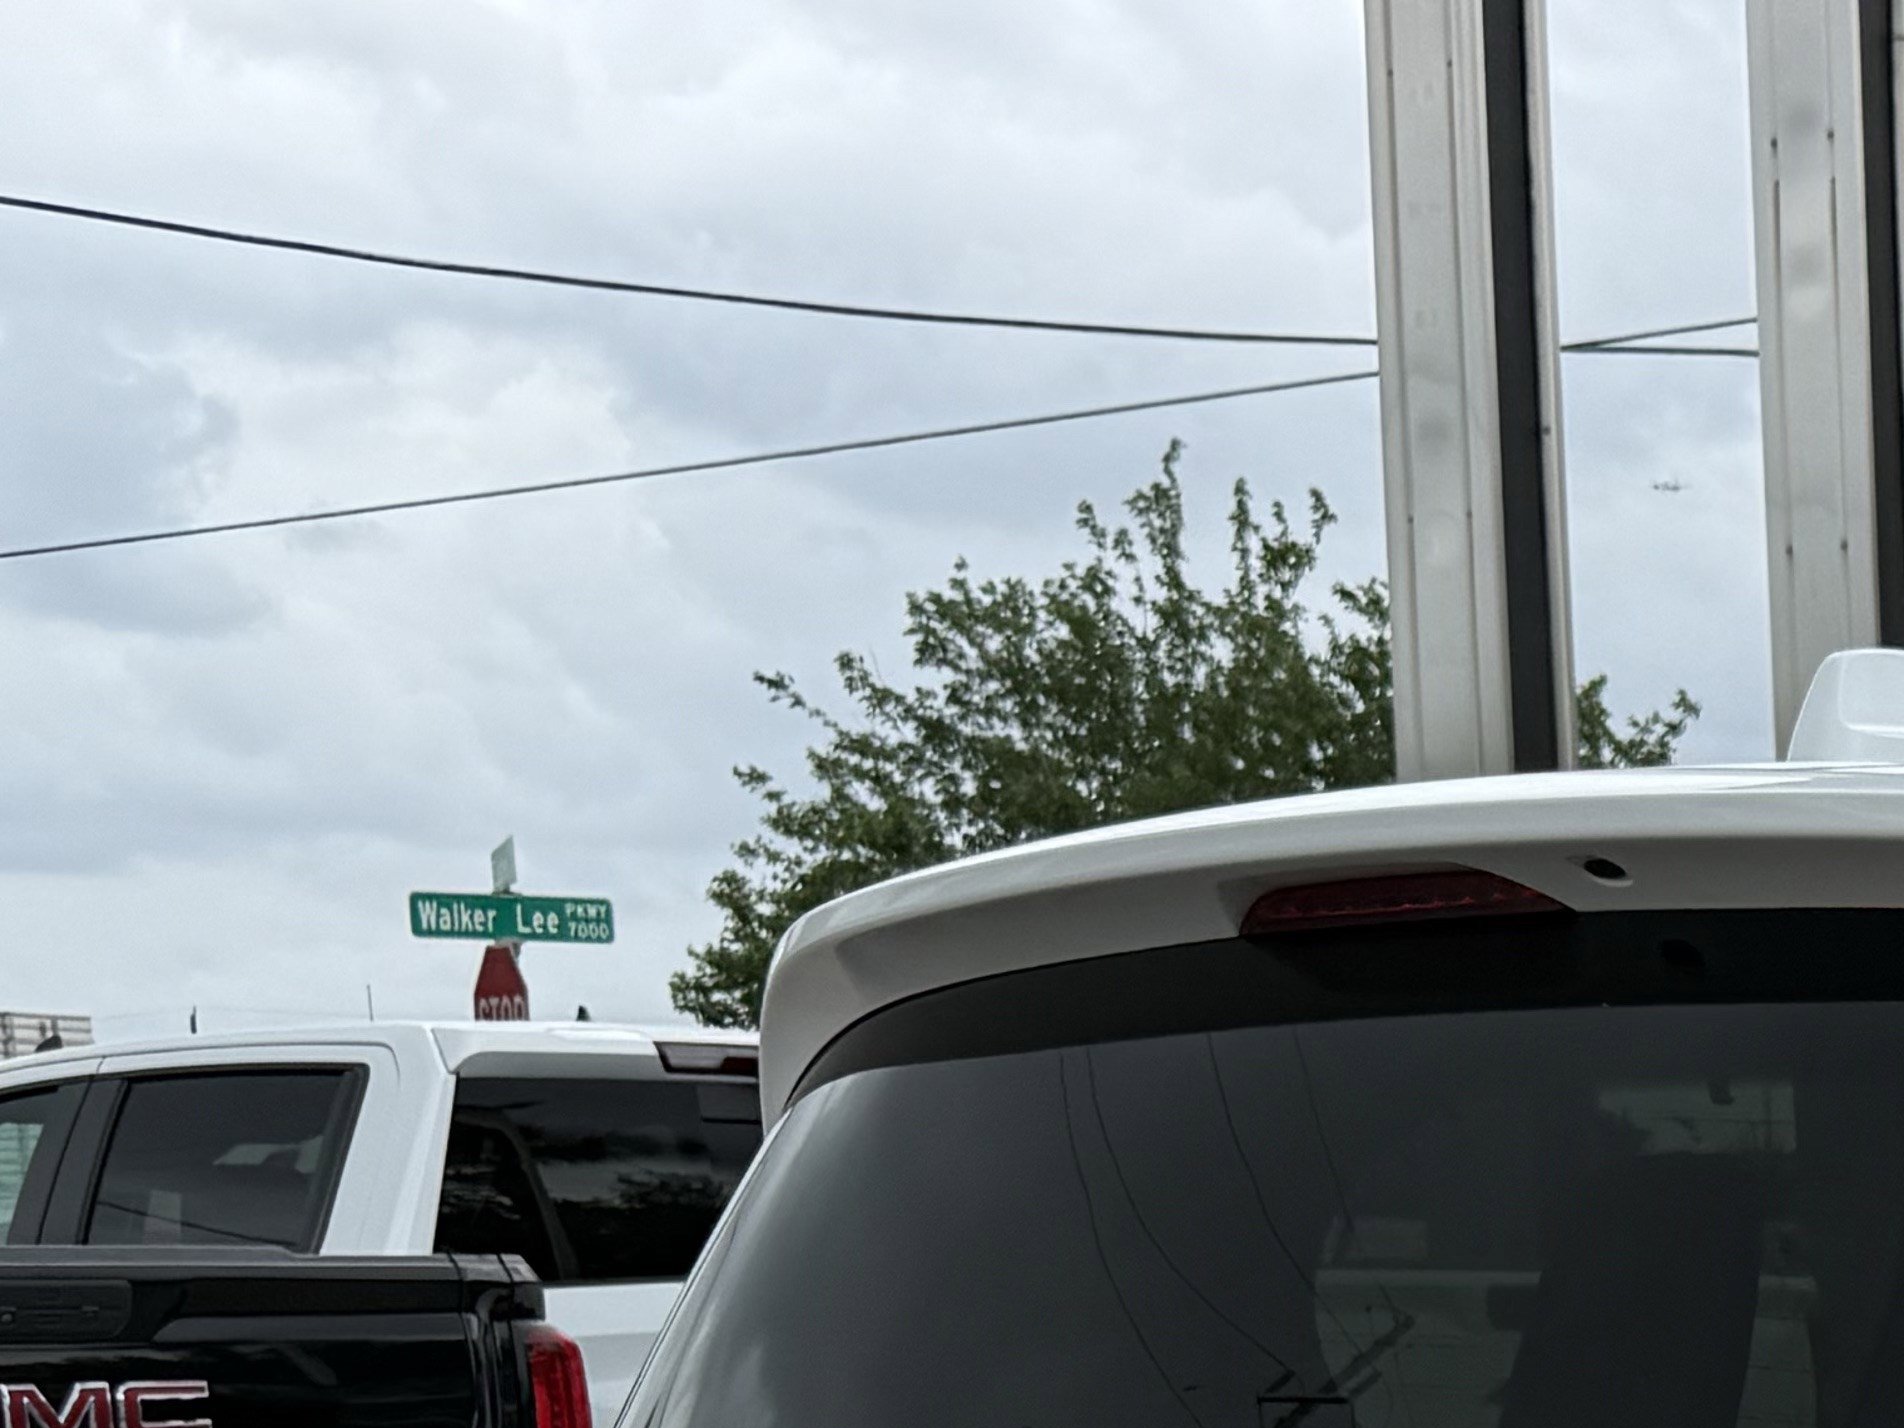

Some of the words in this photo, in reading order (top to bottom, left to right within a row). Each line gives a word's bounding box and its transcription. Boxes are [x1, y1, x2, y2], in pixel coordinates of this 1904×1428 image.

[418, 900, 497, 933] Walker
[516, 903, 560, 935] Lee
[564, 903, 607, 920] PKWY
[567, 921, 610, 940] 7000
